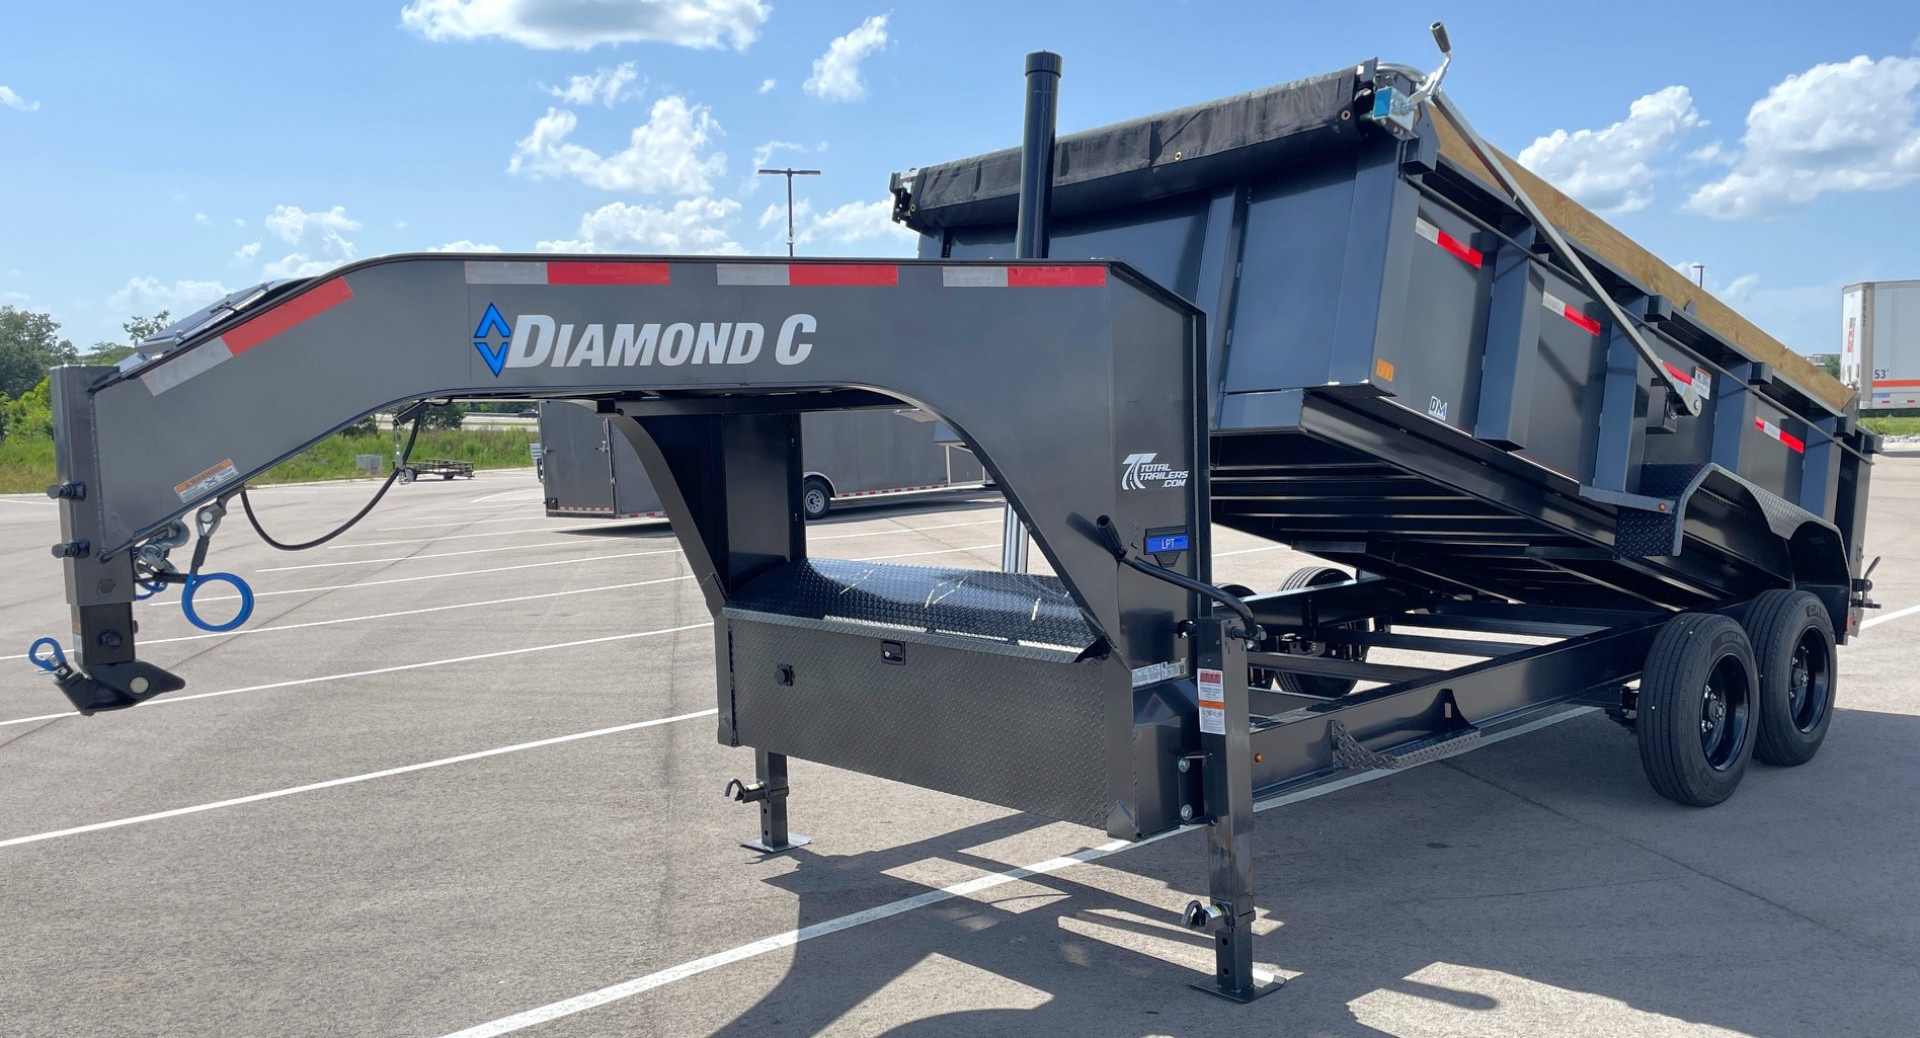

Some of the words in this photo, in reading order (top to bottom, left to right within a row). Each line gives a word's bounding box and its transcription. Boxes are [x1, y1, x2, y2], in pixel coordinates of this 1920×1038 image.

[505, 314, 765, 368] DIAMOND
[775, 313, 817, 366] C
[1140, 463, 1171, 473] TOTAL
[1139, 470, 1189, 481] TRAILERS
[1161, 479, 1187, 488] .COM
[1161, 538, 1175, 549] LPT
